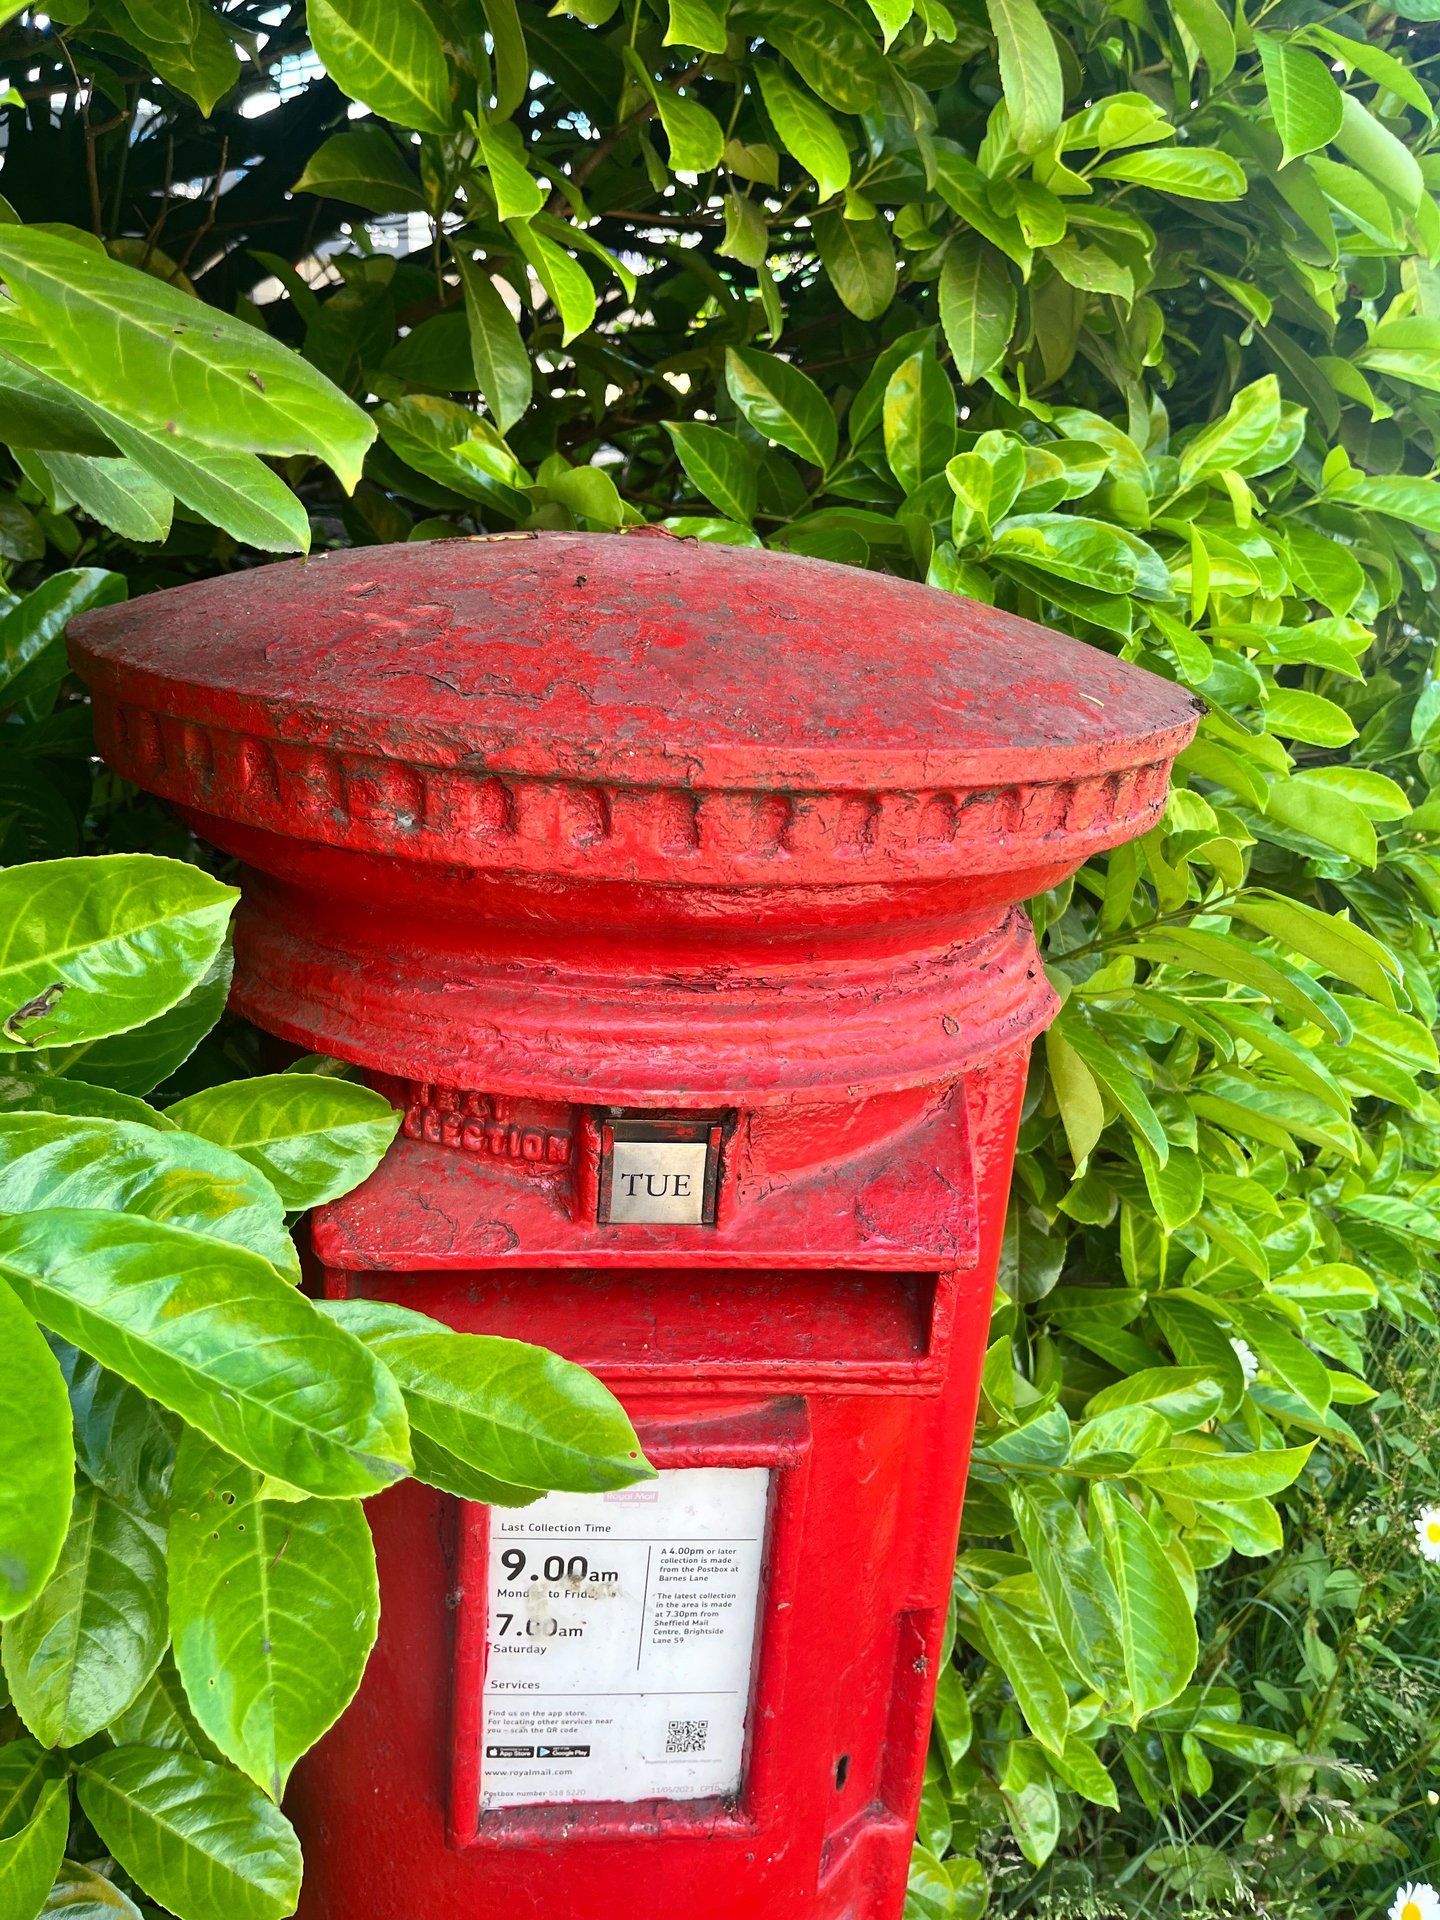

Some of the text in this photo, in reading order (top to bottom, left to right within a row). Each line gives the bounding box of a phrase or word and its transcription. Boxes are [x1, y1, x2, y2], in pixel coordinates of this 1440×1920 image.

[404, 1103, 573, 1165] LLECTION
[621, 1173, 692, 1198] TUE
[606, 1491, 656, 1502] Royal Mail
[501, 1522, 612, 1533] Last Collection Time
[669, 1547, 704, 1556] 4.00pm
[501, 1548, 619, 1582] 9.00am
[548, 1589, 560, 1599] to
[665, 1610, 698, 1618] 7.30pm
[653, 1628, 724, 1636] Centre, Brightside
[493, 1643, 547, 1655] Saturday
[490, 1679, 541, 1690] Services
[551, 1749, 588, 1758] Google Play
[484, 1768, 573, 1777] www.royalmail.com
